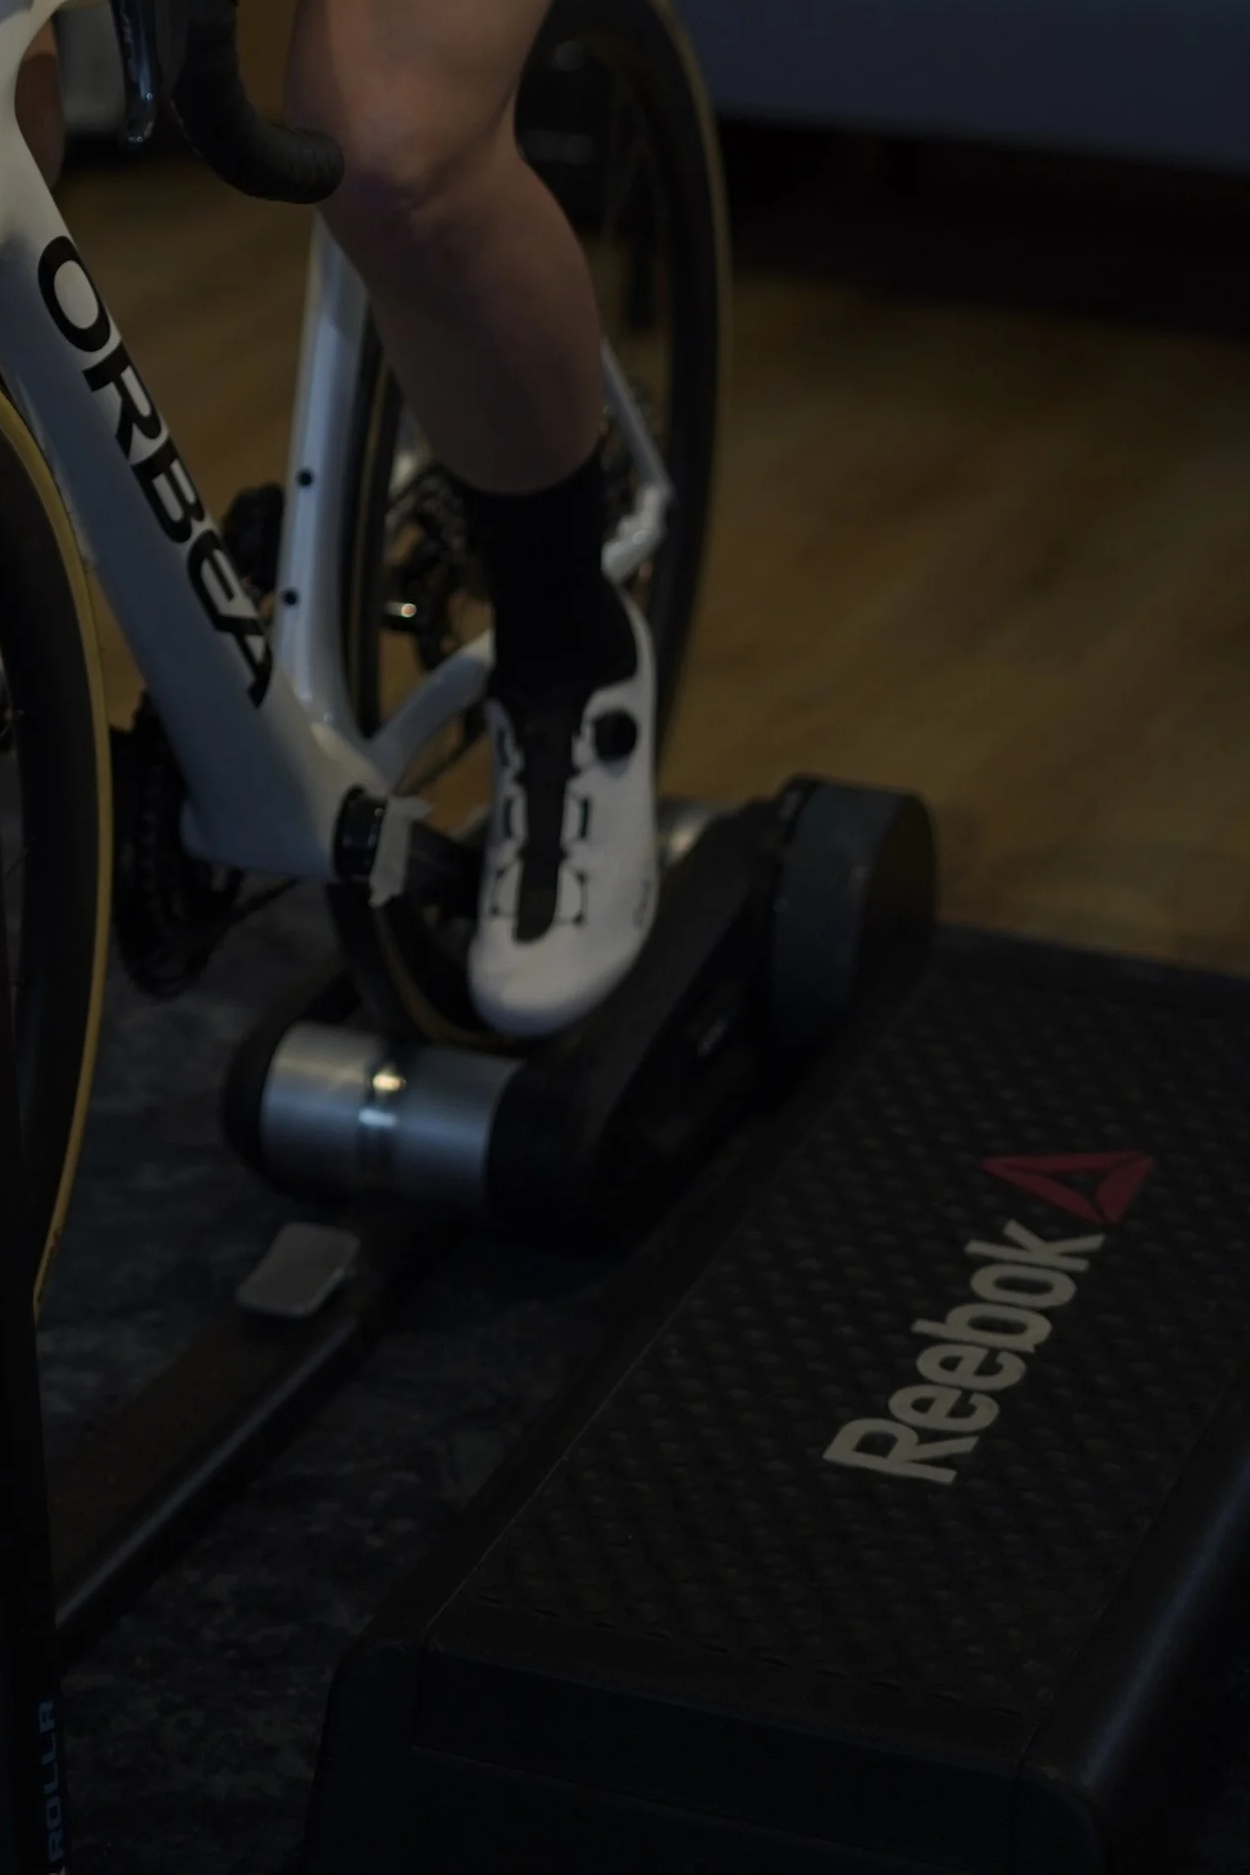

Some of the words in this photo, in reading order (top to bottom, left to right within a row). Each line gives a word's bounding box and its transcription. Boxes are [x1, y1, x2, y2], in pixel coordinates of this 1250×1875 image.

[37, 235, 273, 708] ORBEA
[821, 1218, 1107, 1486] Reebok
[37, 1699, 65, 1863] ROLLR
